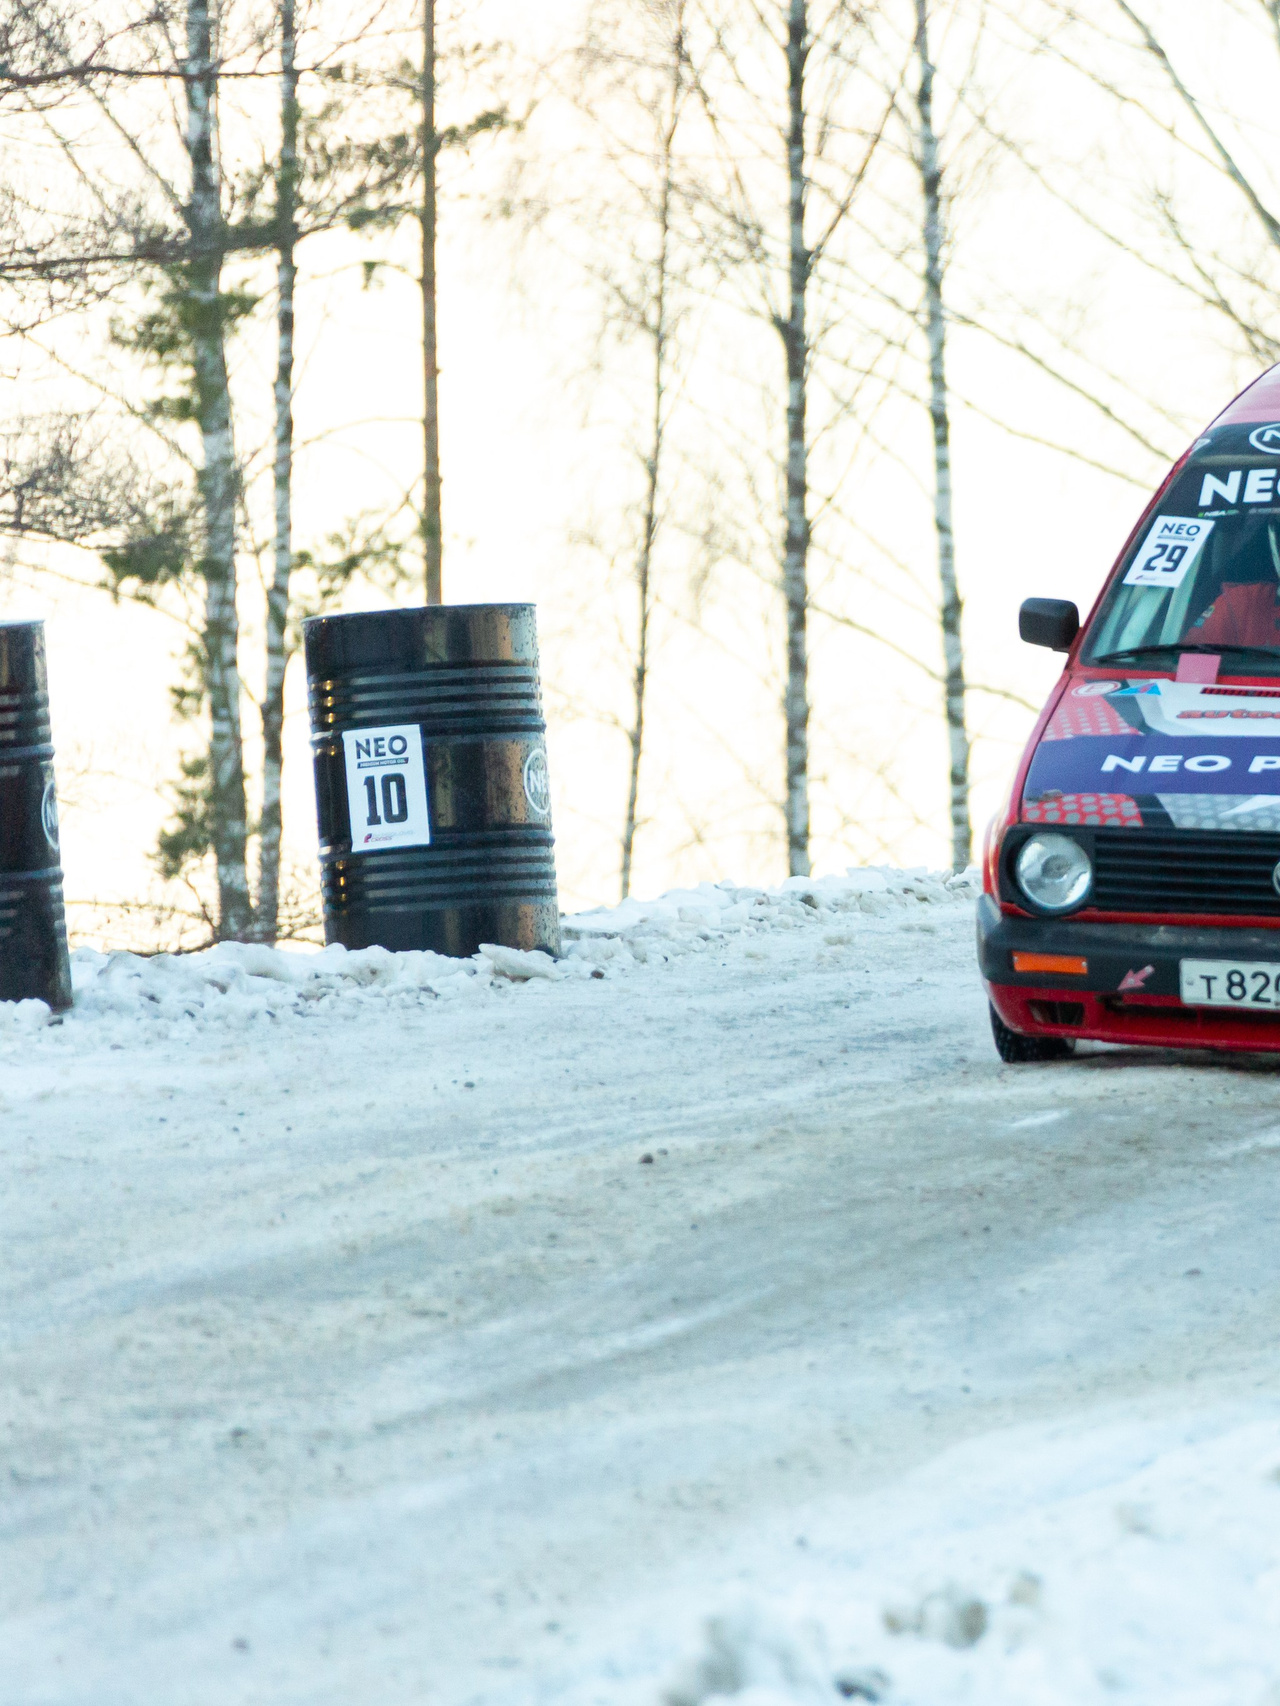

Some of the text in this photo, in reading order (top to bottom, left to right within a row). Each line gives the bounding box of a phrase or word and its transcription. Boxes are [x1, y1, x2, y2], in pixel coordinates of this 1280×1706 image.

[1160, 522, 1201, 536] NEO
[1142, 543, 1188, 572] 29
[355, 735, 408, 760] NEO
[1101, 755, 1232, 774] NEO
[364, 773, 408, 826] 10
